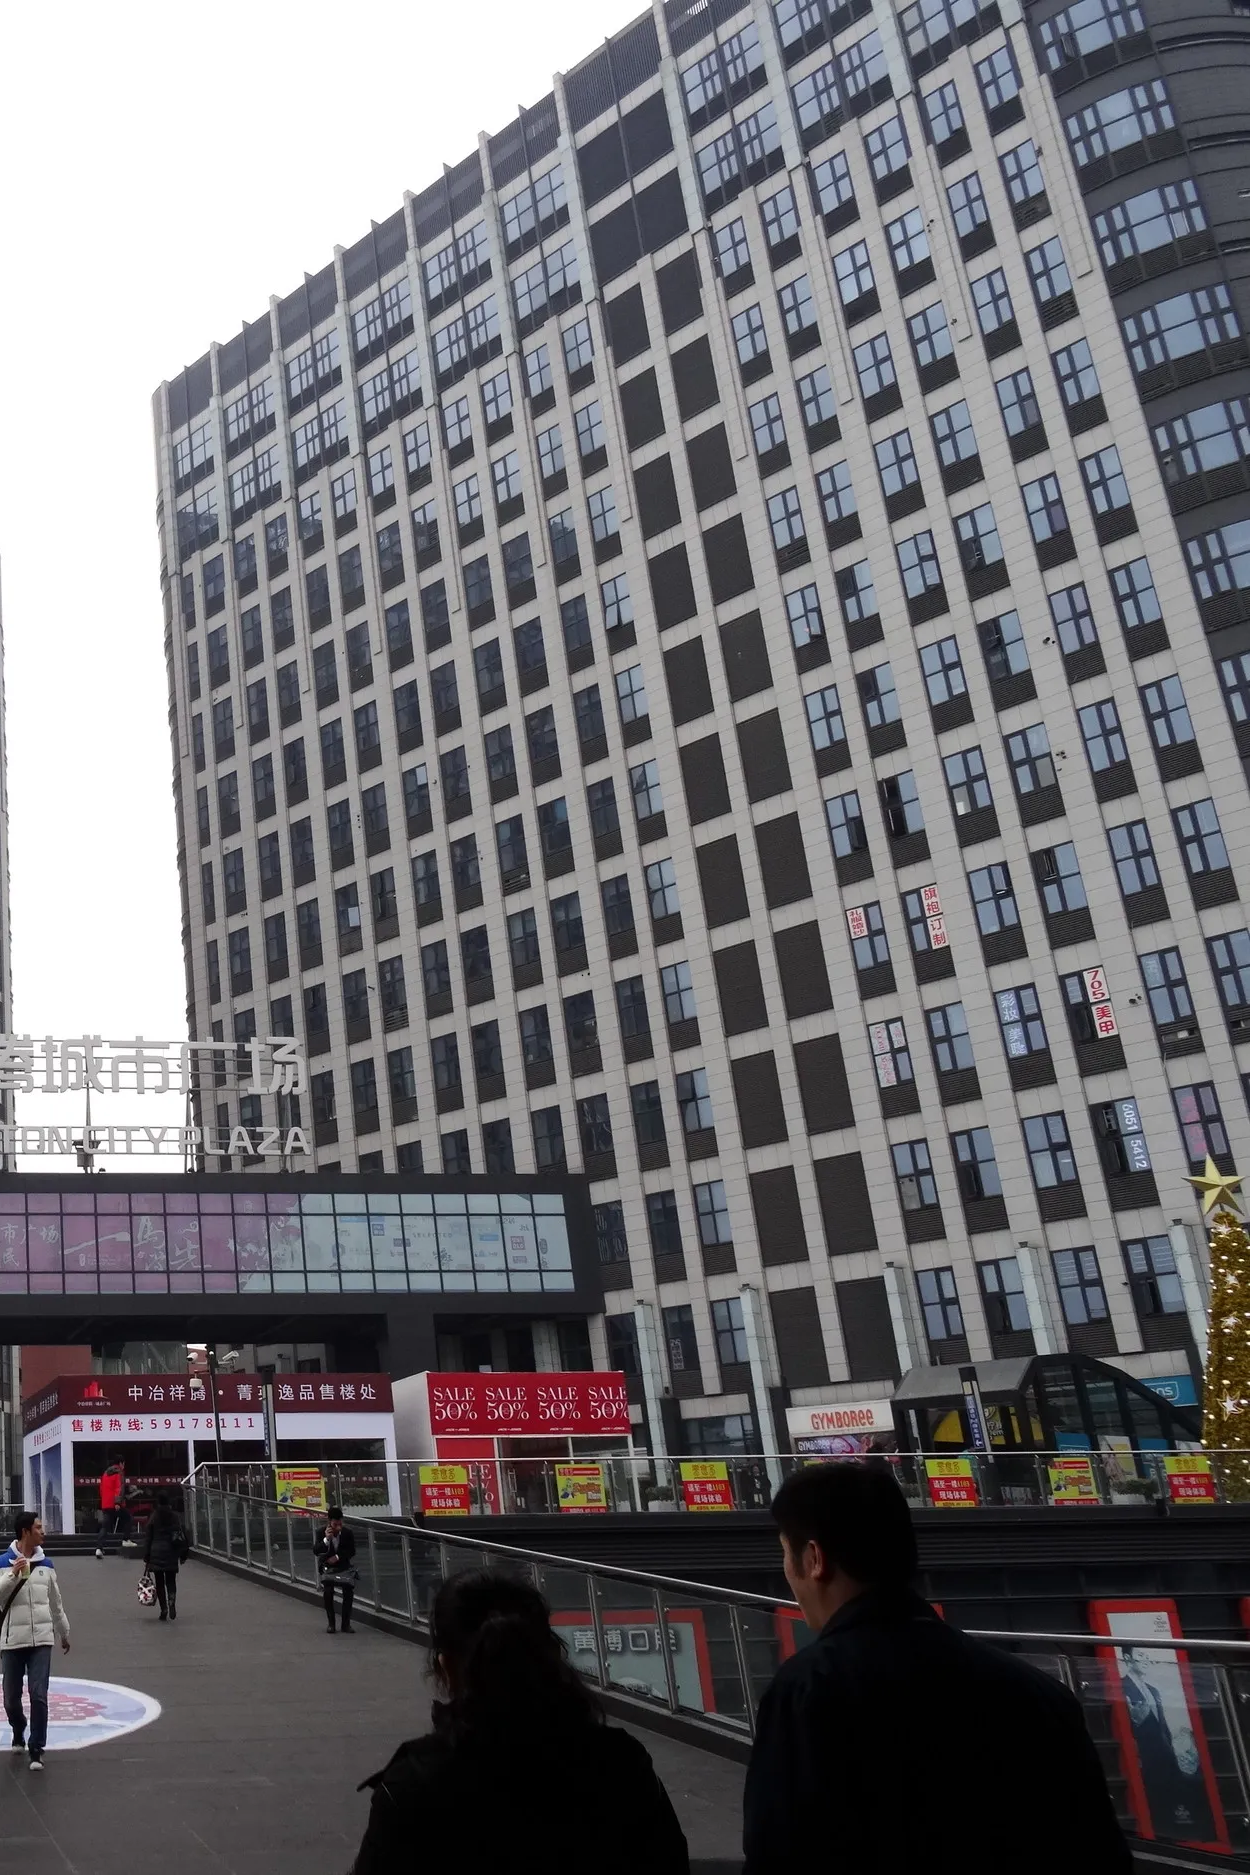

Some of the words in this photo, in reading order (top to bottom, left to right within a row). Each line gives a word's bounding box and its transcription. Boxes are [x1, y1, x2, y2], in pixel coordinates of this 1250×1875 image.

[83, 1126, 169, 1155] CITY
[181, 1126, 311, 1156] PLAZA
[434, 1387, 475, 1400] SALE
[485, 1387, 527, 1400] SALE
[537, 1386, 578, 1400] SALE
[588, 1386, 627, 1400] SALE
[434, 1402, 478, 1421] 50%
[486, 1402, 530, 1421] 50%
[538, 1402, 581, 1421] 50%
